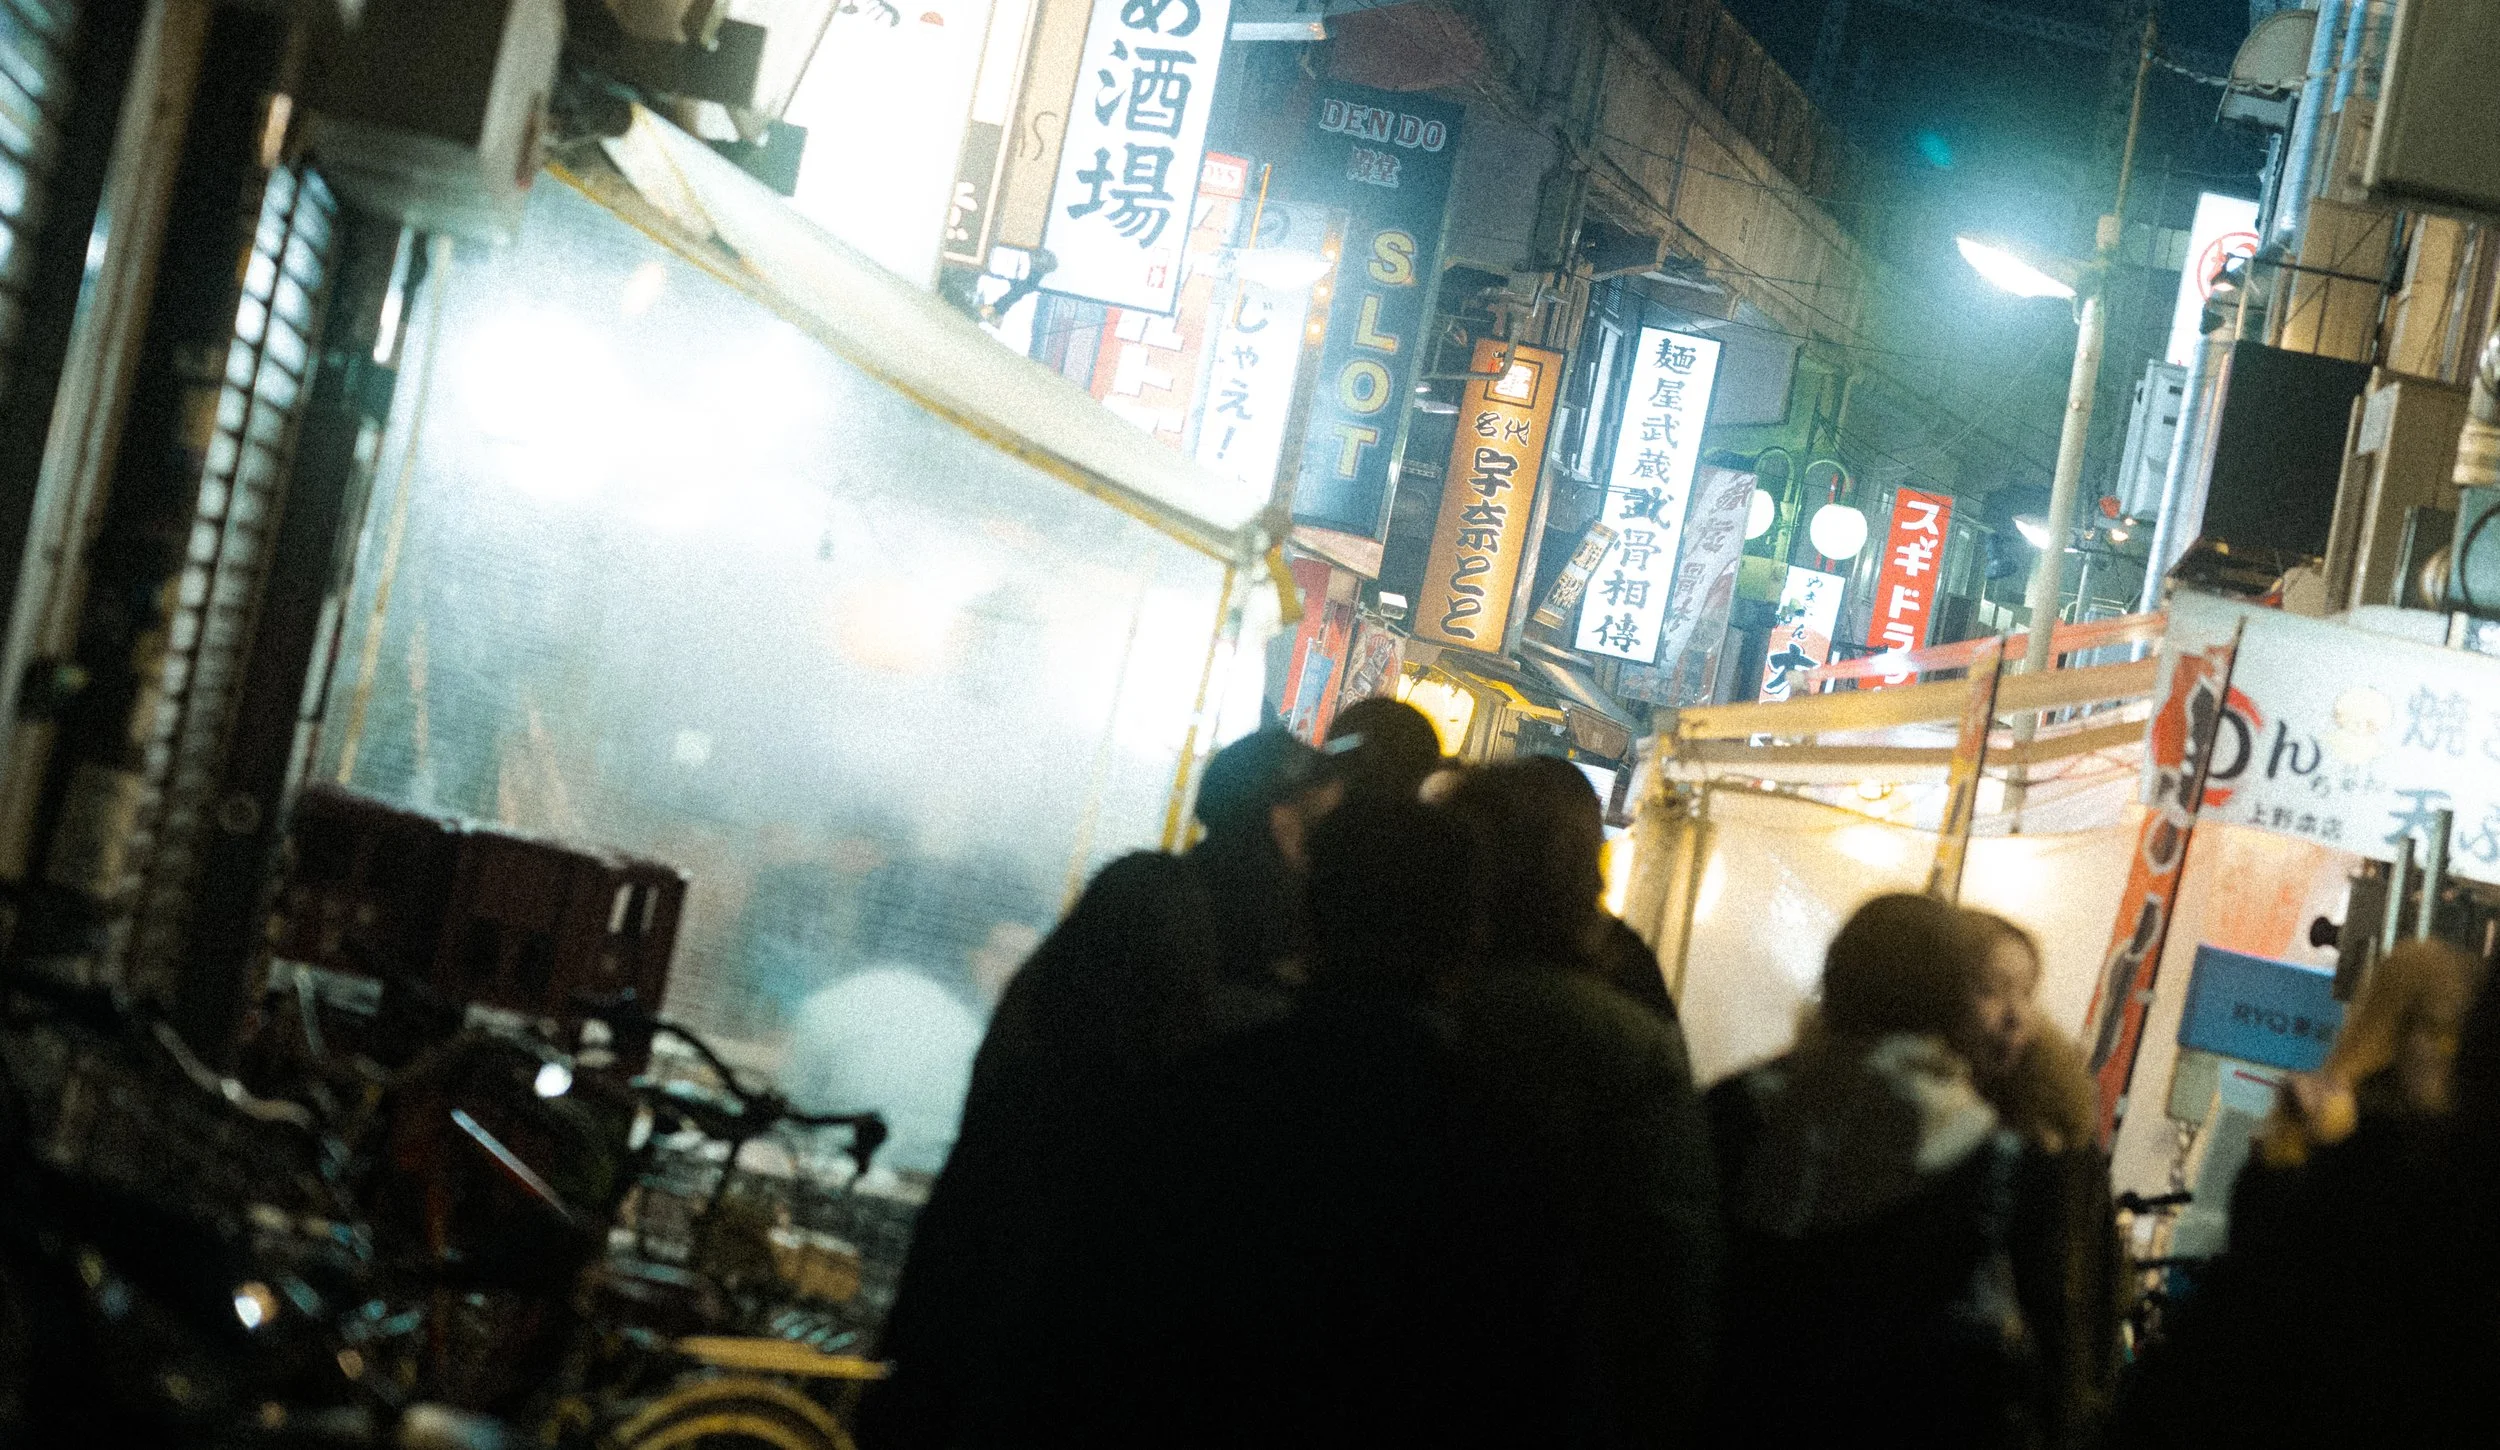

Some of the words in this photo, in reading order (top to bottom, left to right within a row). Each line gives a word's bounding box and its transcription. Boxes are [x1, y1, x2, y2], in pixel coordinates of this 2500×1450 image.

[1319, 98, 1394, 143] DEN
[1394, 113, 1447, 152] DO
[1333, 230, 1416, 480] SLOT
[1440, 446, 1519, 640] 宇奈とと
